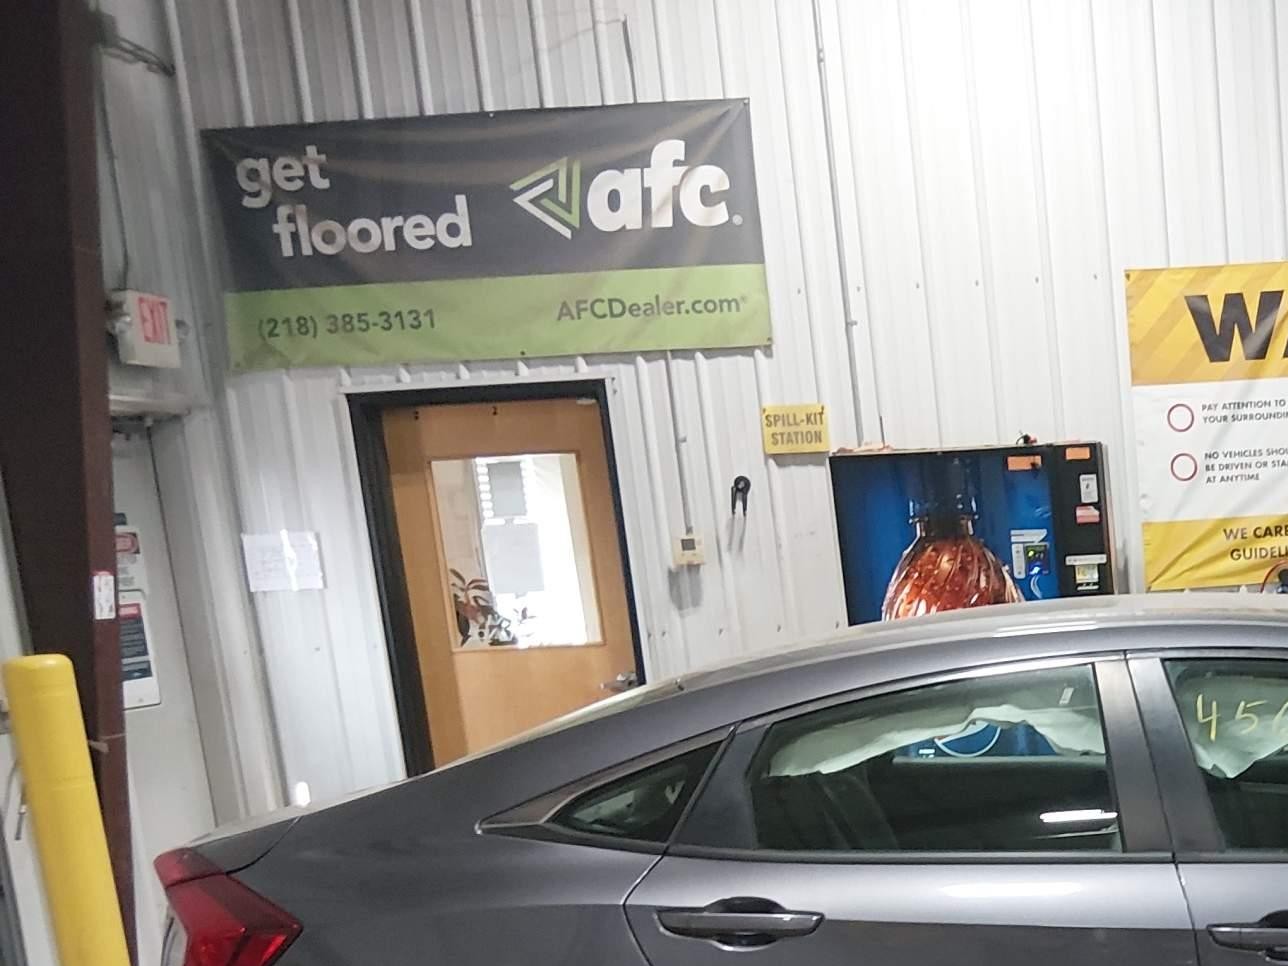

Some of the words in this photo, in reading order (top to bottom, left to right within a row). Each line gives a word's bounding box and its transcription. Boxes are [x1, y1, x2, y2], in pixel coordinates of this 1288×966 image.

[236, 145, 330, 208] get
[273, 195, 472, 257] floored
[139, 297, 171, 344] EXIT
[257, 316, 318, 339] (218)
[326, 308, 436, 334] 385-3131
[1202, 402, 1218, 411] PAY
[1222, 400, 1271, 410] ATTENTION
[1274, 399, 1286, 408] TO
[765, 411, 824, 427] SPILL-KIT
[1203, 414, 1229, 424] YOUR
[771, 430, 823, 446] STATION
[1204, 451, 1219, 460] NO
[1222, 449, 1263, 459] VEHICLES
[1205, 463, 1215, 472] BE
[1218, 462, 1251, 471] DRIVEN
[1255, 460, 1268, 469] OR
[1206, 475, 1217, 484] AT
[1219, 473, 1260, 483] ANYTIME
[1223, 527, 1248, 541] WE
